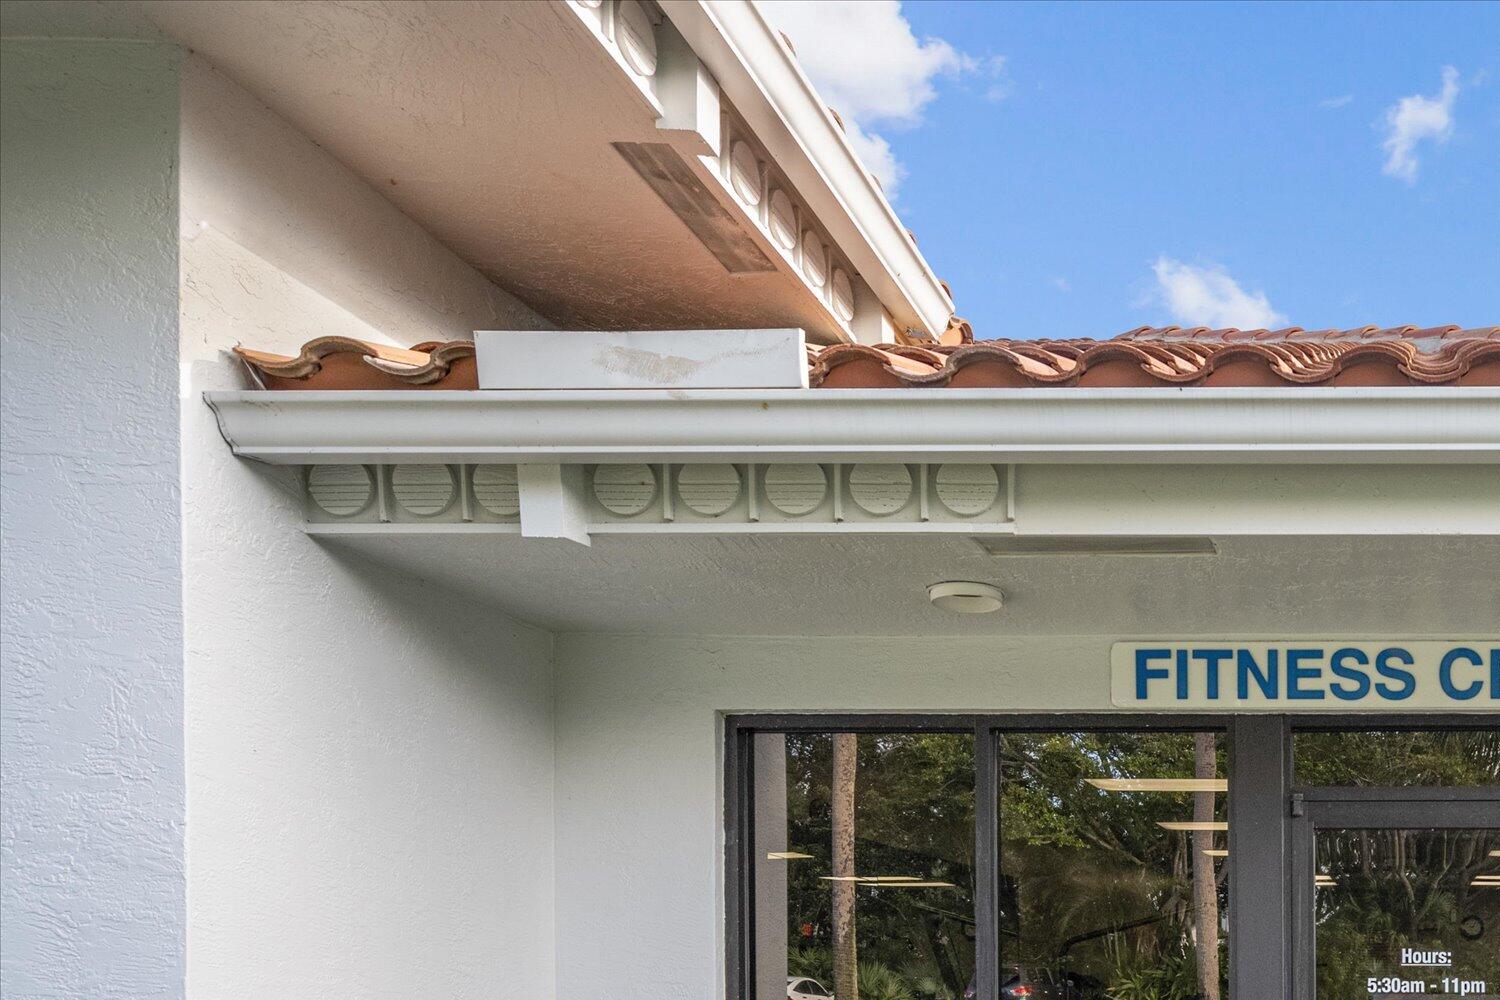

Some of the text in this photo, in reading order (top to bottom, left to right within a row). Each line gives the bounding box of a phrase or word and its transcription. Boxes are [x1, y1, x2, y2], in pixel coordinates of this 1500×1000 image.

[1135, 648, 1416, 701] FITNESS
[1402, 948, 1451, 963] Hours:
[1368, 978, 1425, 993] 5:30am
[1442, 978, 1485, 995] 11pm
